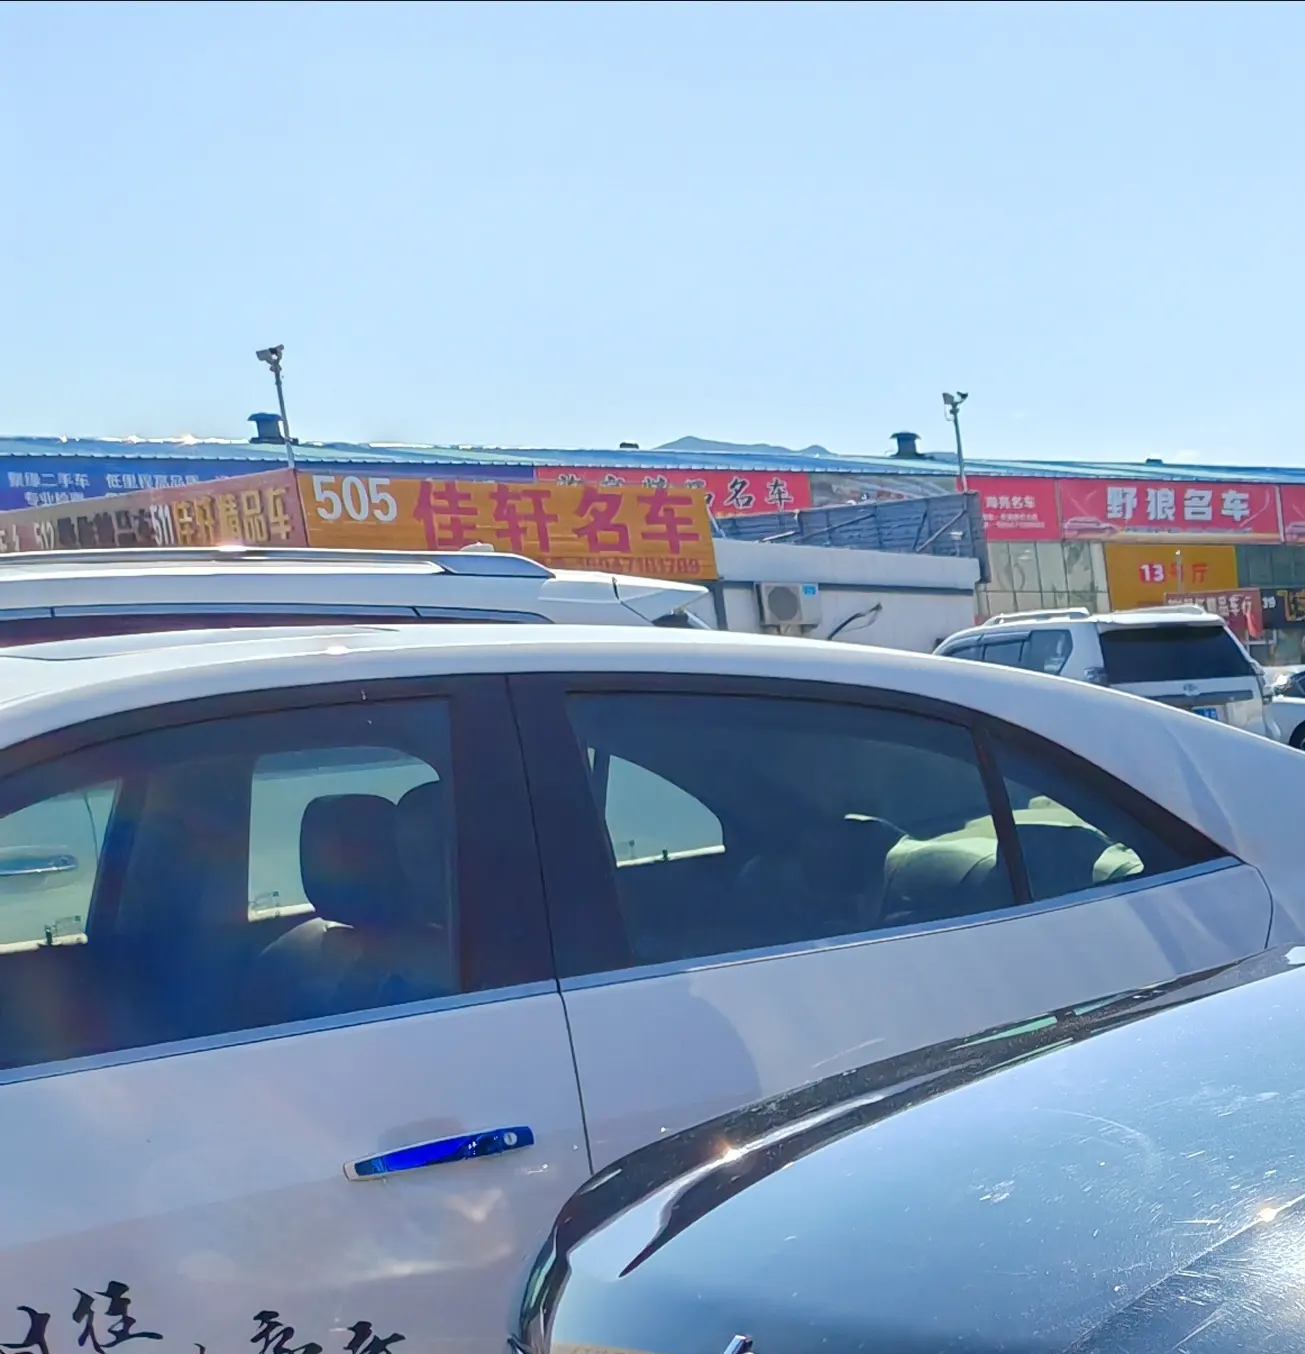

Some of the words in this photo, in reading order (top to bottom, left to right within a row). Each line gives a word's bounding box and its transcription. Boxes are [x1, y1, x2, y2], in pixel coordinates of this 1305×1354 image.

[312, 475, 398, 522] 505
[413, 480, 699, 555] 佳轩名车
[1107, 486, 1250, 522] 野狼名车
